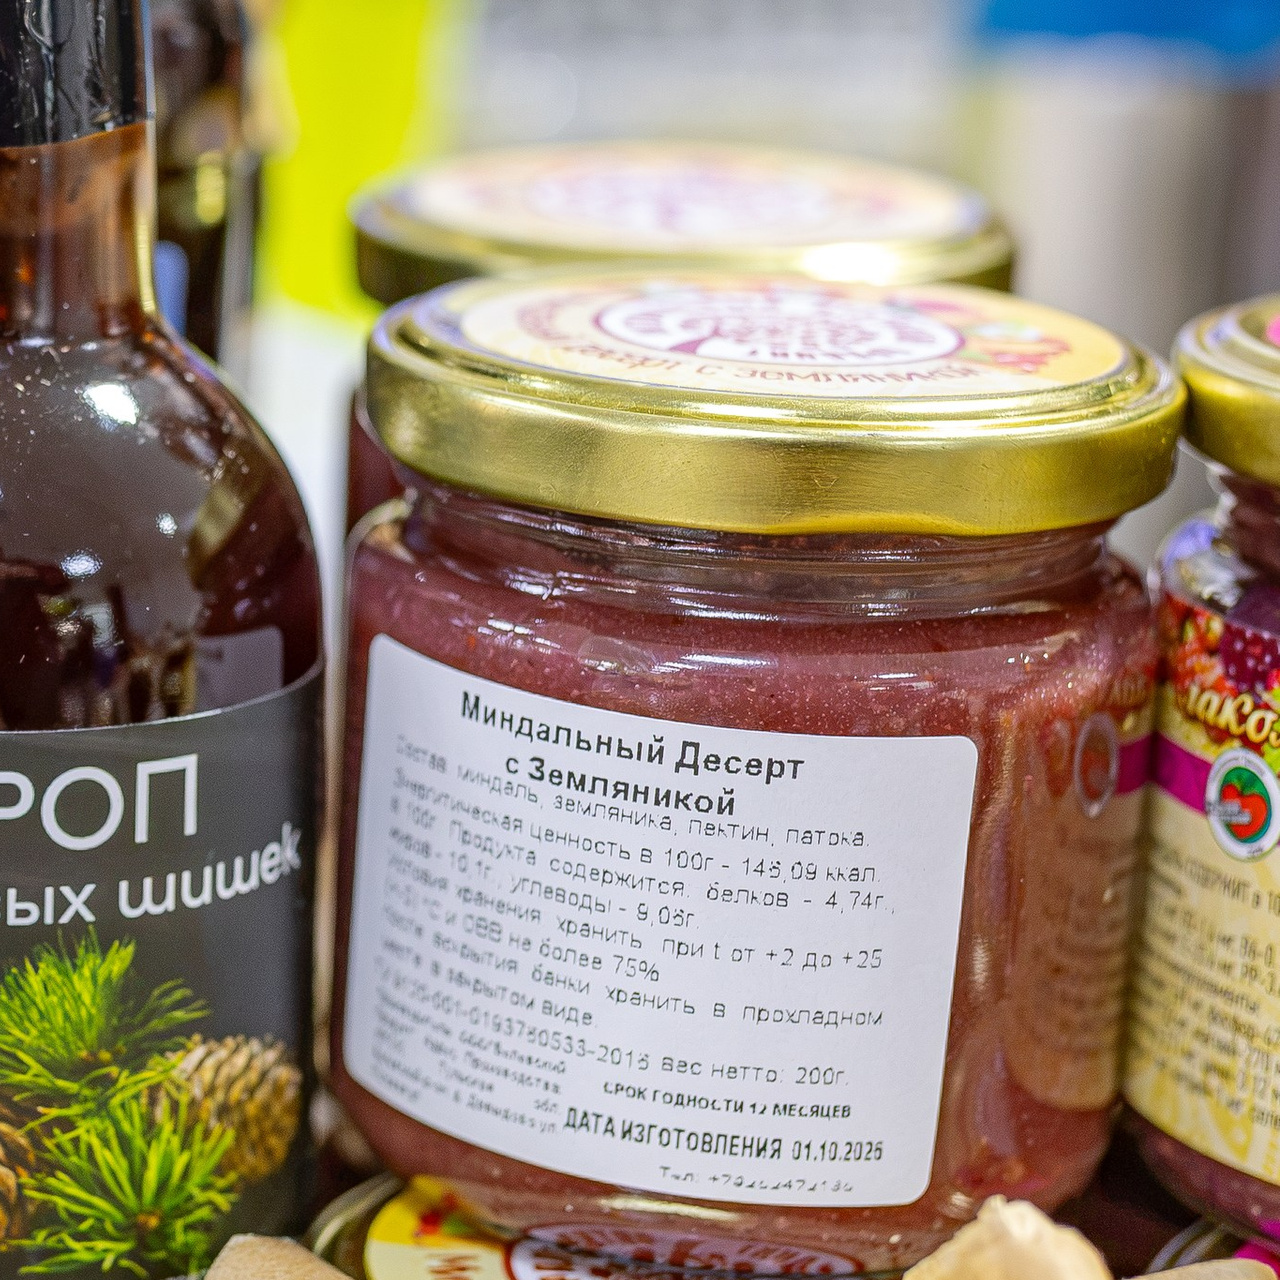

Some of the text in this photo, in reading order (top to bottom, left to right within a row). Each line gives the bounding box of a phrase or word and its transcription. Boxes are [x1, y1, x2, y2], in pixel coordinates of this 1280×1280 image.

[460, 691, 805, 785] Миндальный Десерт
[505, 757, 735, 816] с Земляникой
[554, 795, 677, 835] земляника,
[688, 819, 774, 847] пектин,
[786, 829, 870, 847] патока.
[119, 822, 302, 919] шишек
[530, 825, 631, 860] ценность
[640, 848, 653, 864] в
[665, 848, 714, 872] 100г
[825, 866, 881, 884] ккал.
[509, 875, 612, 915] углеводы
[706, 881, 790, 908] белков
[538, 937, 603, 970] более
[612, 954, 660, 982] 75%
[556, 917, 643, 950] хранить
[662, 937, 704, 960] при
[731, 947, 756, 963] от
[766, 949, 795, 968] +2
[802, 951, 832, 972] до
[842, 949, 883, 970] +25
[531, 963, 591, 997] банки
[605, 985, 696, 1016] хранить
[713, 1002, 726, 1018] в
[742, 1004, 884, 1029] прохладном
[603, 1080, 648, 1101] СРОК
[651, 1088, 744, 1114] ГОДНОСТИ
[772, 1103, 851, 1122] МЕСЯЦЕВ
[710, 1060, 784, 1085] нетто:
[795, 1066, 849, 1087] 200г.
[564, 1106, 884, 1162] ДАТА ИЗГОТОВЛЕНИЯ 01.10.2026
